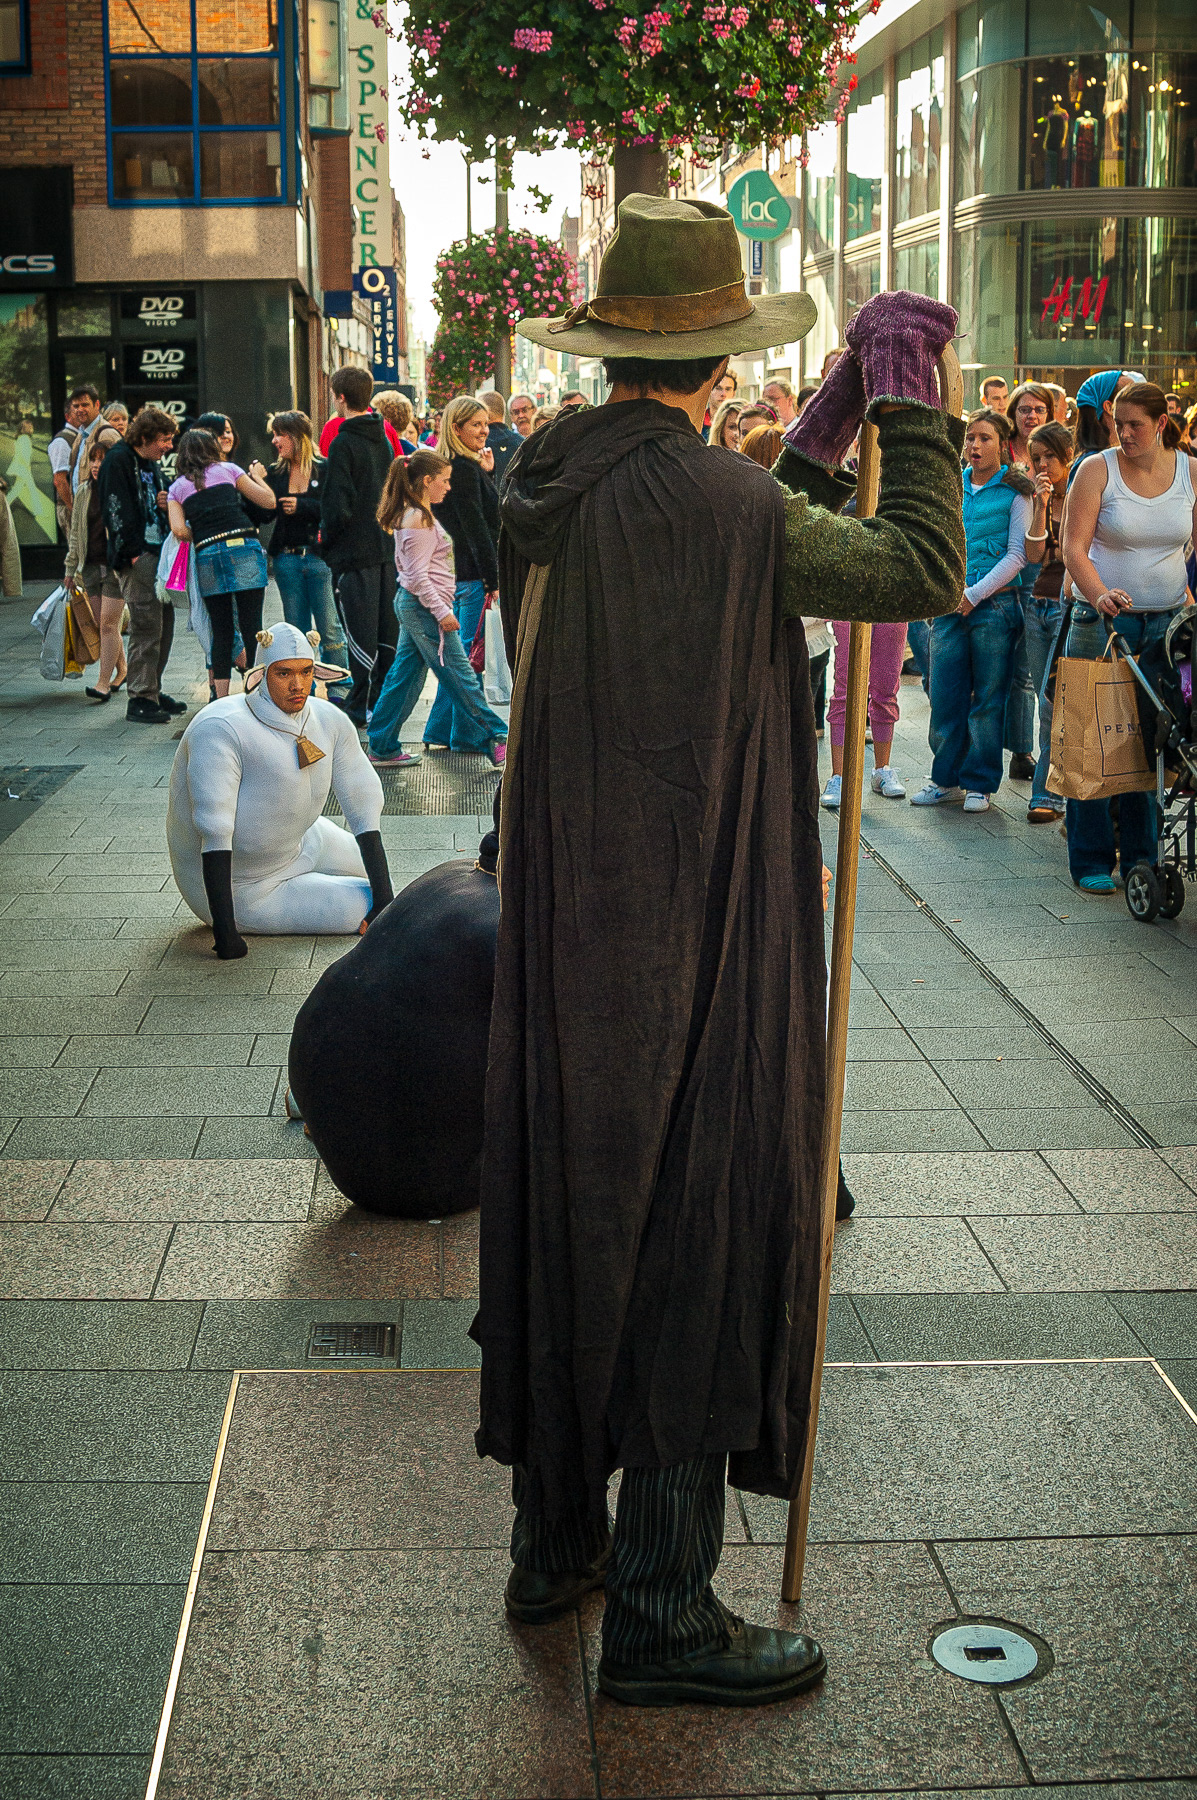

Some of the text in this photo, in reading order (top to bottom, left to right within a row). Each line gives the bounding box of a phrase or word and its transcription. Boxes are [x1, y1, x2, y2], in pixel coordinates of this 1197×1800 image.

[355, 44, 380, 267] SPENCER
[0, 255, 55, 273] CS
[362, 268, 391, 297] O2
[140, 296, 184, 312] DVD
[1041, 275, 1110, 323] H&M
[373, 301, 383, 365] ERVIS
[385, 297, 394, 368] JERVIS
[142, 348, 185, 364] DVD
